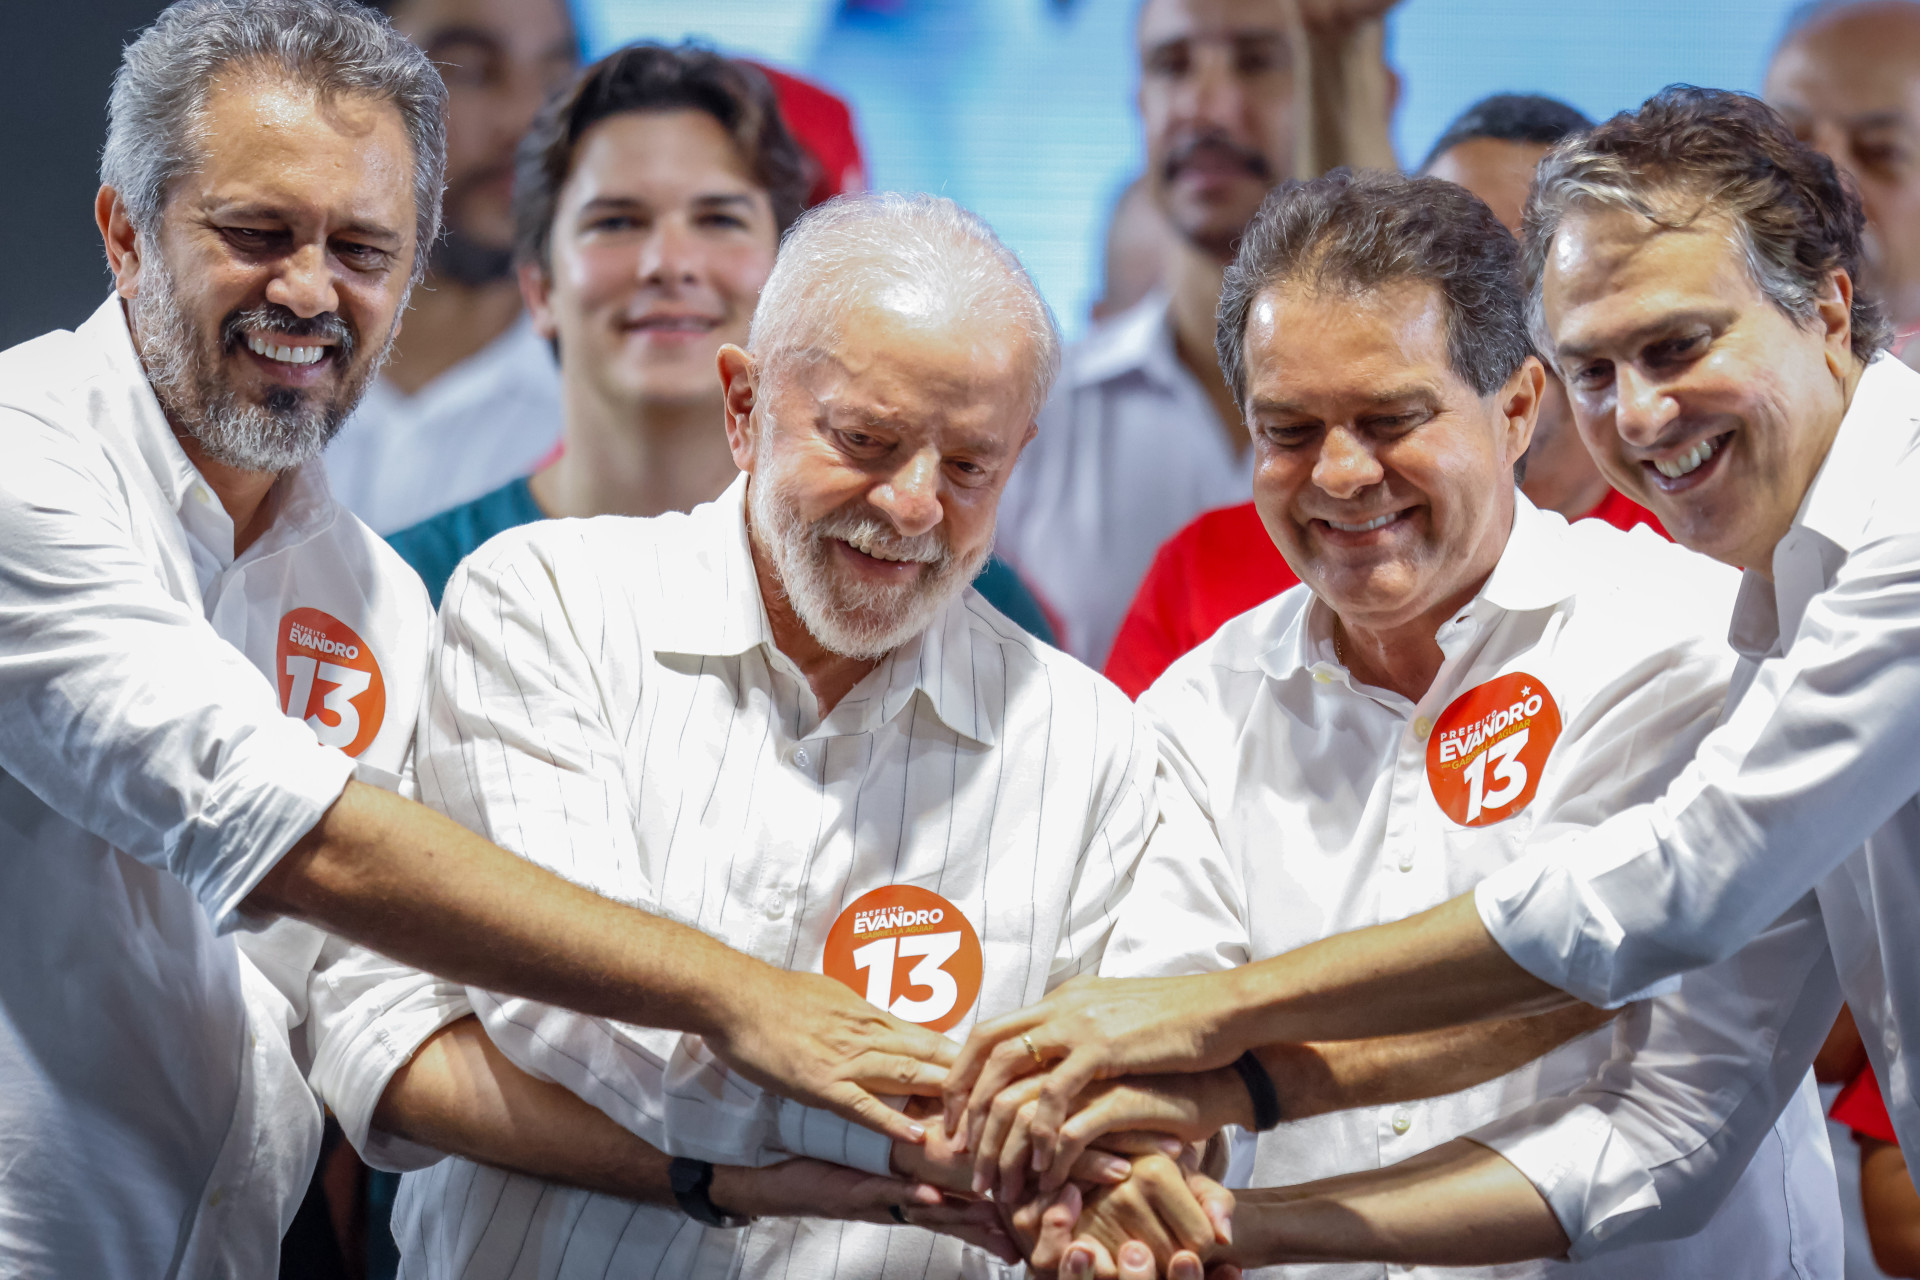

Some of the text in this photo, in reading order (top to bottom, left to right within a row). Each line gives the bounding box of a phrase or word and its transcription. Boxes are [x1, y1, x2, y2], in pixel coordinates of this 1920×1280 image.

[289, 628, 359, 660] EVANDRO
[286, 655, 372, 749] 13
[1439, 694, 1543, 763] EVANDRO
[1440, 709, 1498, 741] PREFEITO
[1497, 718, 1531, 743] AGUIAR
[1463, 727, 1530, 824] 13
[853, 908, 944, 934] EVANDRO
[855, 905, 905, 919] PREFEITO
[861, 927, 904, 940] GABRIELLA
[905, 924, 934, 933] AGUIAR
[852, 930, 962, 1023] 13
